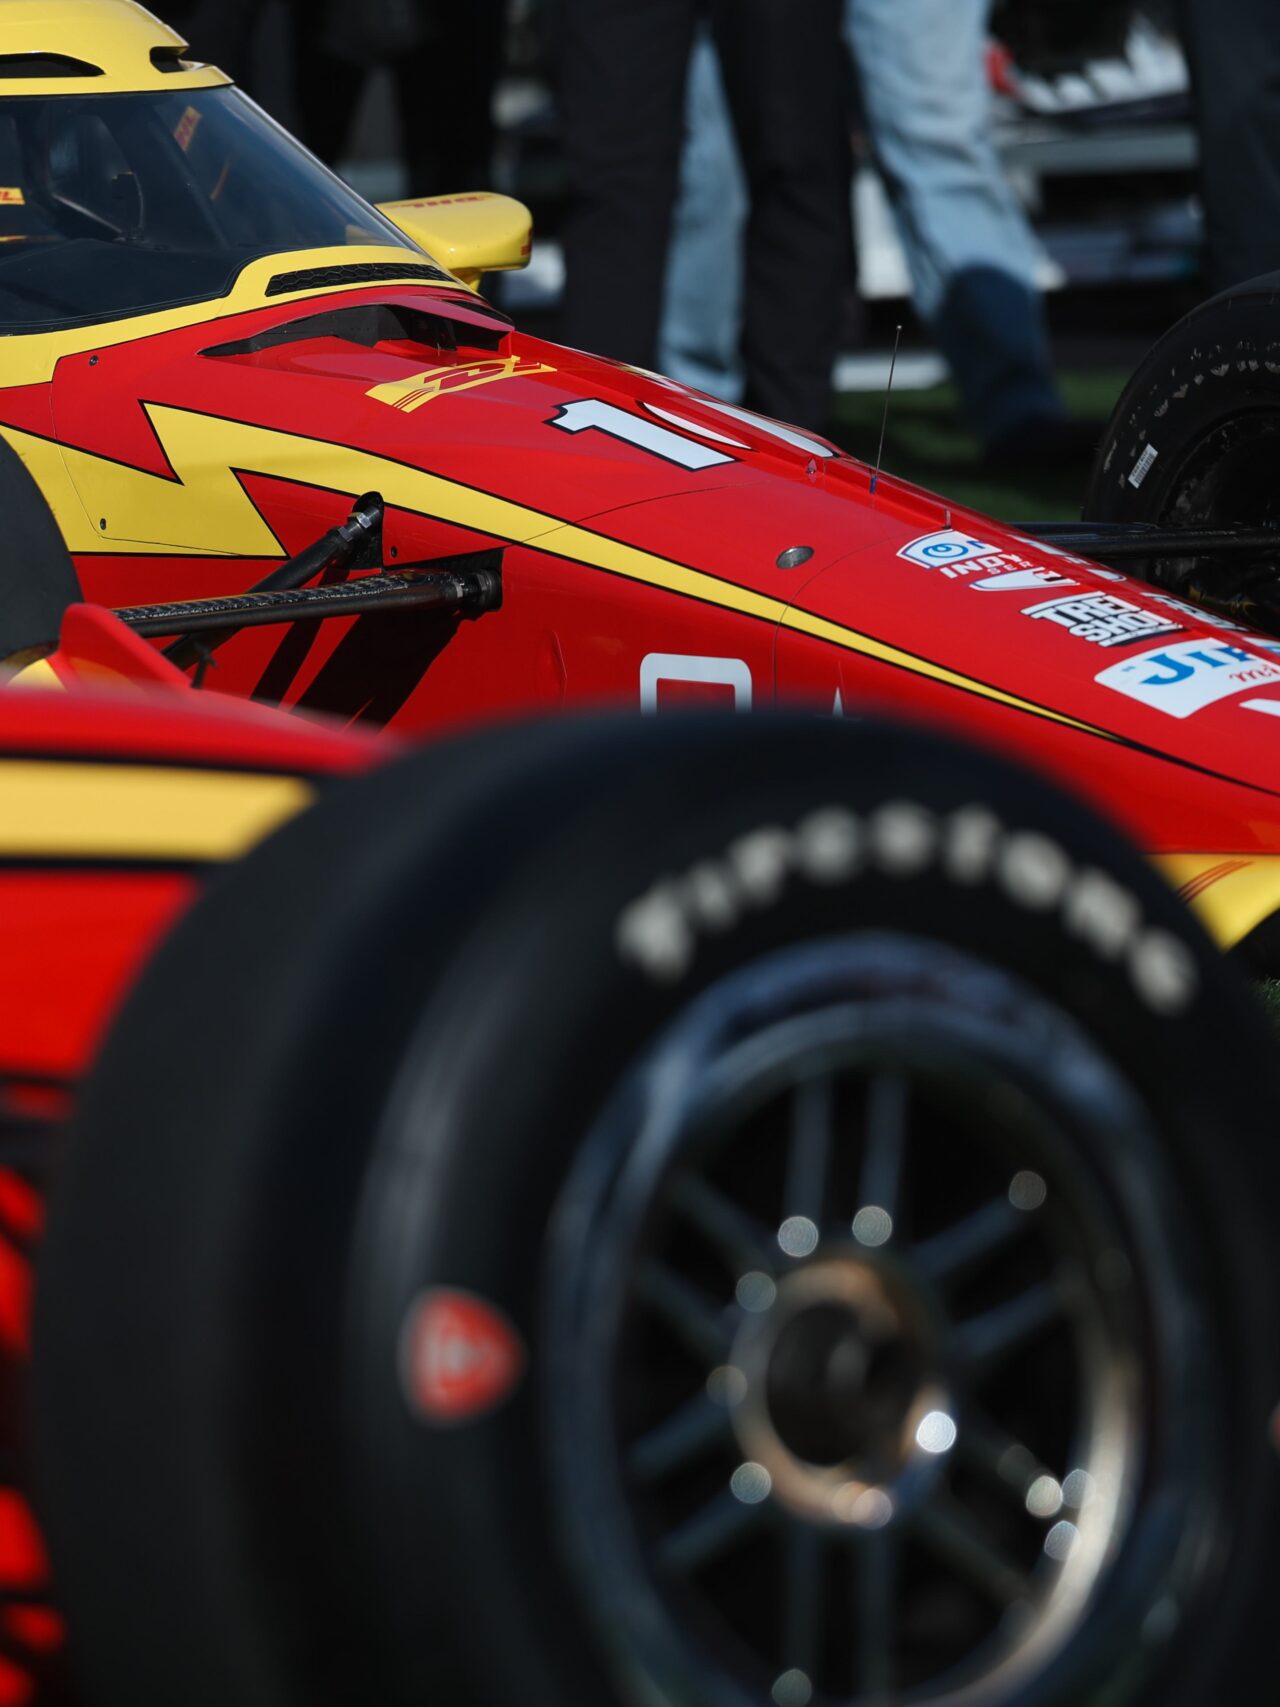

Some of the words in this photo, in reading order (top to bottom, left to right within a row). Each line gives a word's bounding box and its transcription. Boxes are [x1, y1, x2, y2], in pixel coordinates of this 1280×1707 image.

[939, 552, 1025, 579] INDY
[986, 560, 1033, 575] SER
[616, 801, 1197, 1012] Firestone
